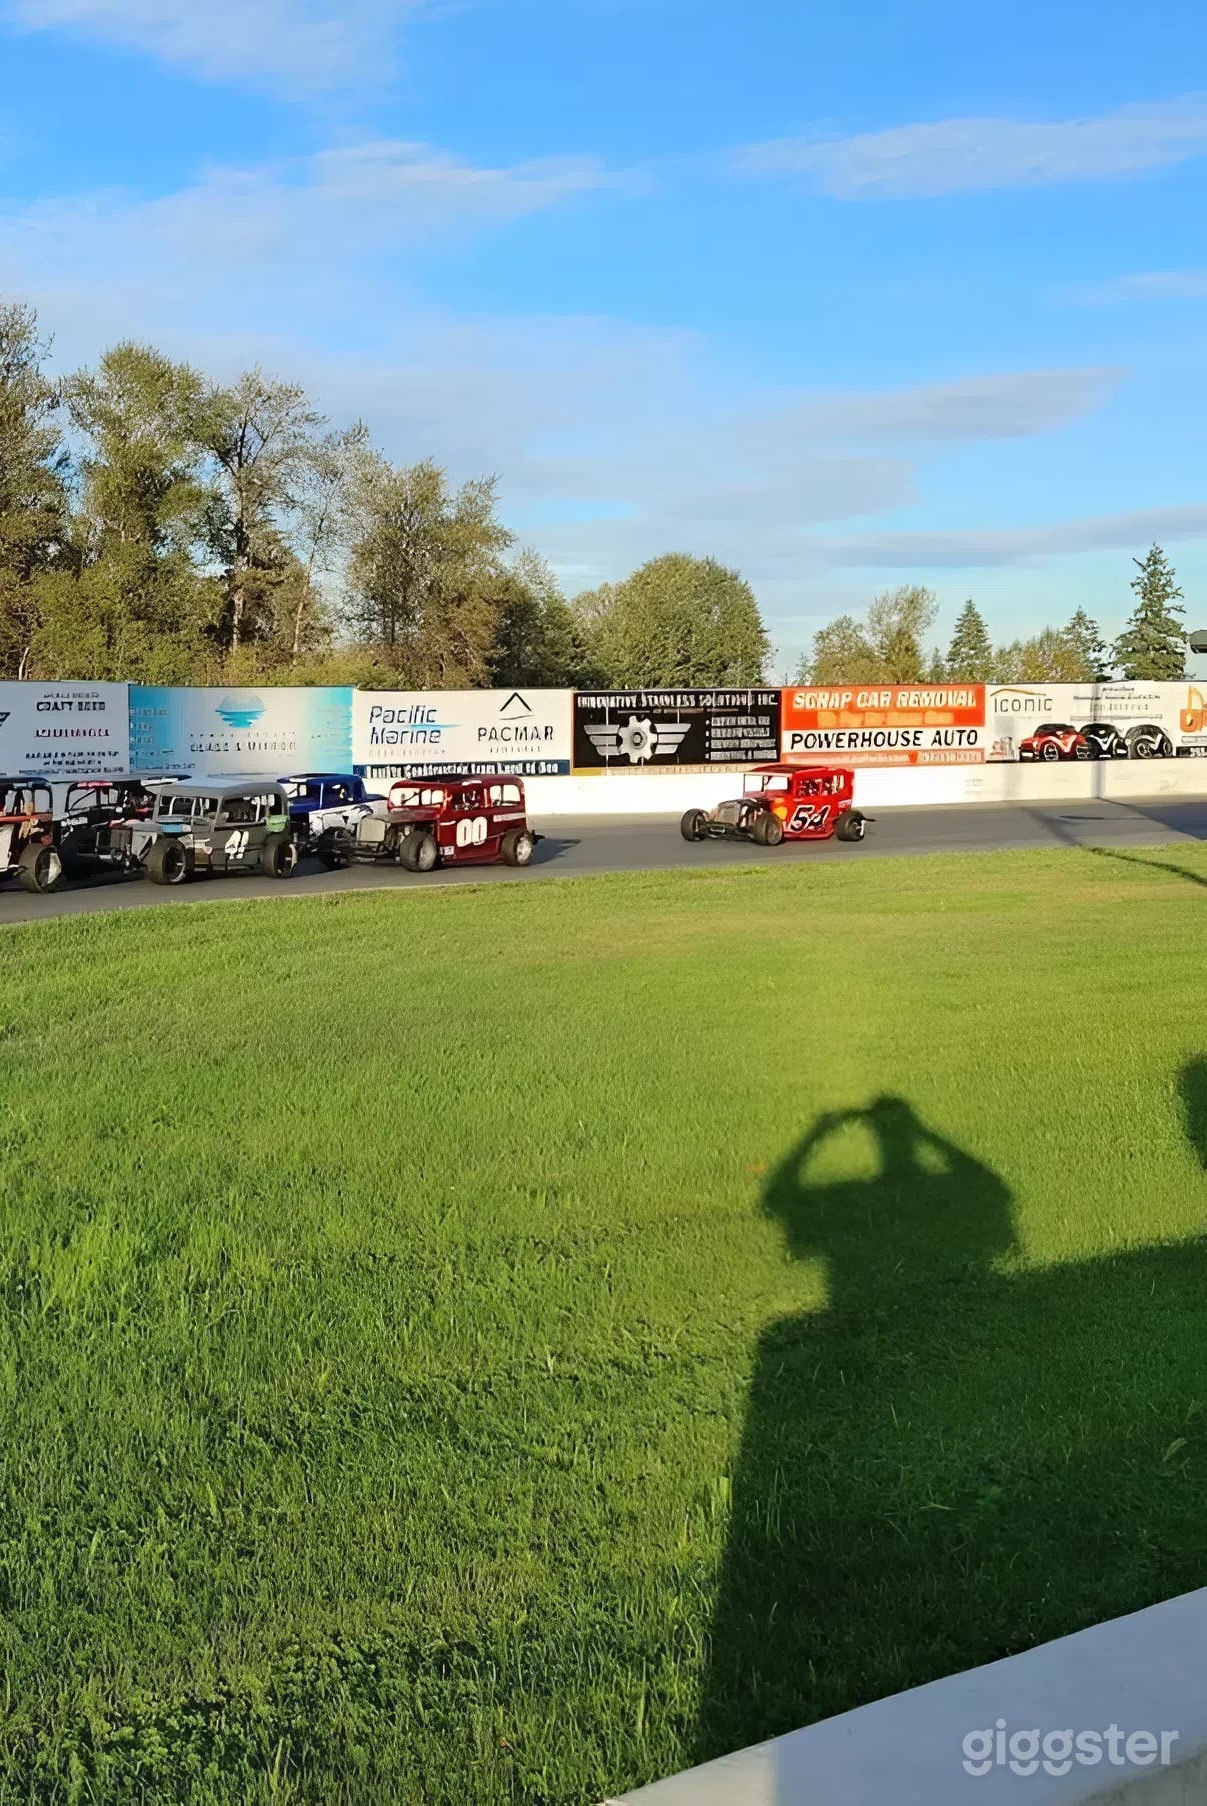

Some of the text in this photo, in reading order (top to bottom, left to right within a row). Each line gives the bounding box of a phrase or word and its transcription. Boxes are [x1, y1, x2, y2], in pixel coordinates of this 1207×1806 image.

[792, 690, 977, 709] SCRAP CAR REMOVAL
[369, 705, 438, 725] Pacific
[370, 727, 442, 745] Marine
[477, 725, 554, 742] PACMAR
[790, 730, 924, 749] POWERHOUSE
[930, 729, 979, 746] AUTO
[456, 816, 488, 848] 00
